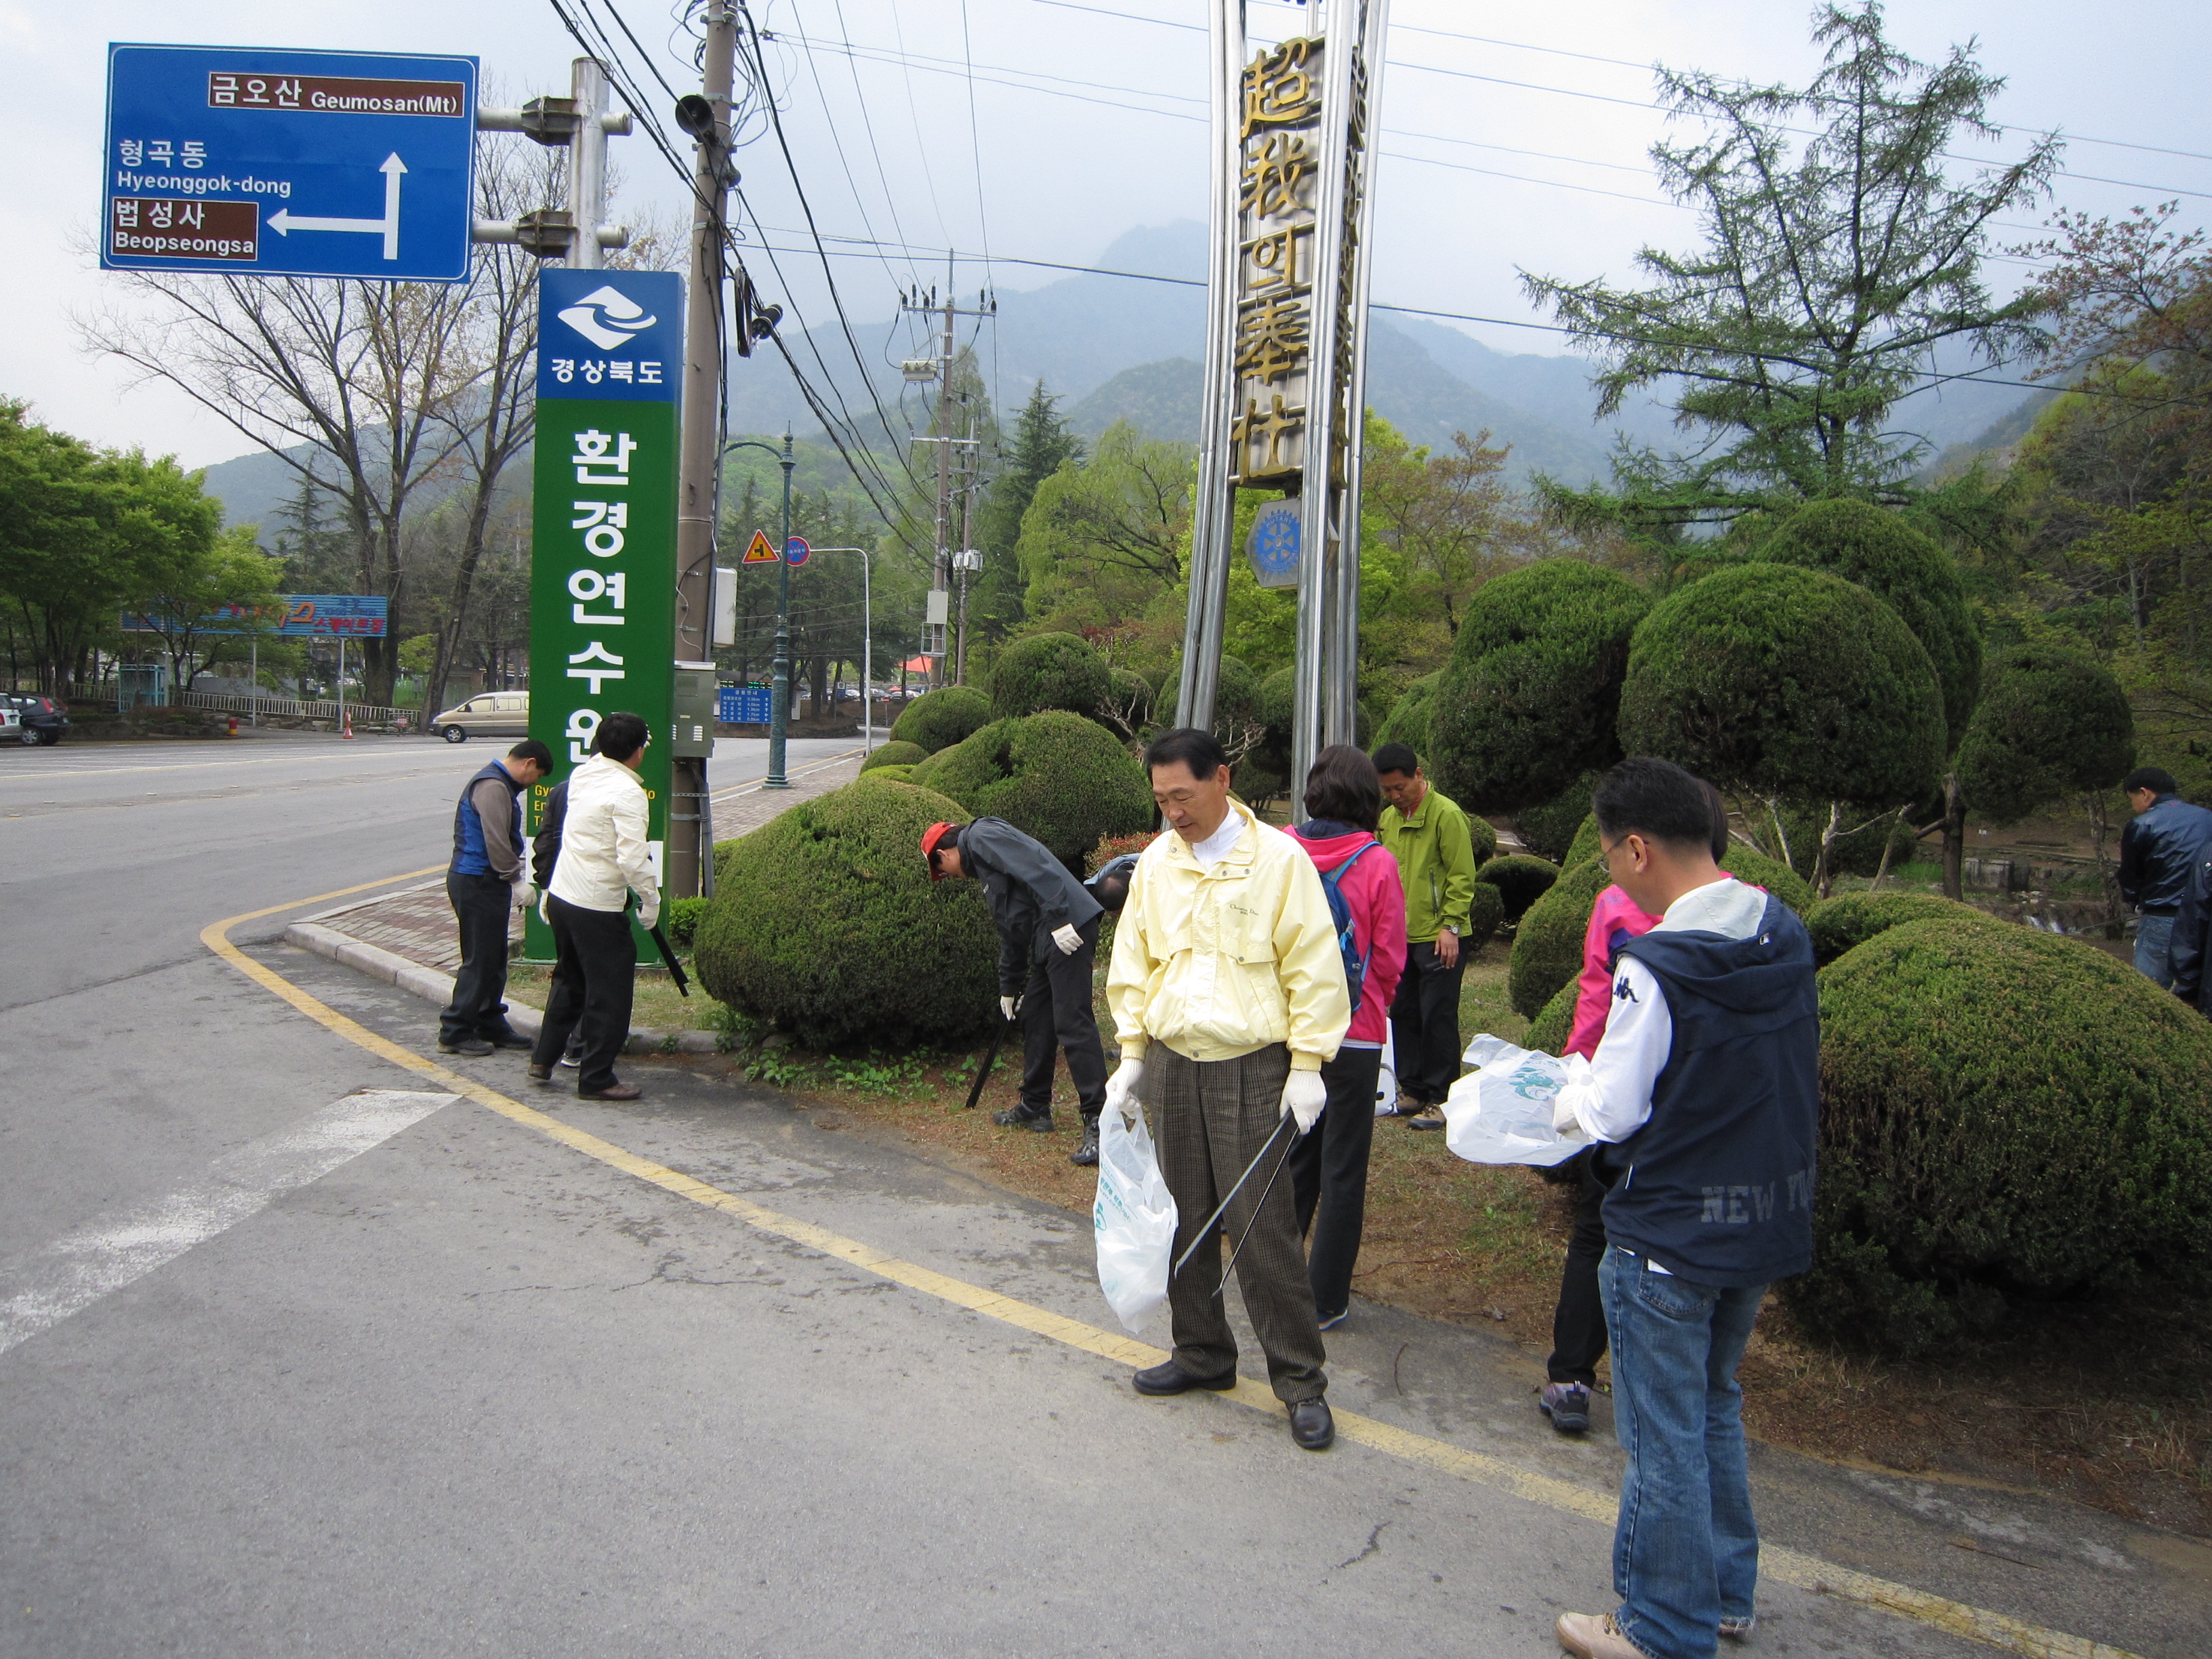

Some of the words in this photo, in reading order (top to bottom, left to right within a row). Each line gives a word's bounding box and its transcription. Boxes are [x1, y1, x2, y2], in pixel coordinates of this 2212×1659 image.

[212, 76, 302, 107] 금오산
[310, 90, 458, 116] Geumosan(Mt)
[119, 140, 207, 169] 형곡동
[117, 170, 291, 198] Hyeonggok-dong
[116, 201, 206, 230] 법성사
[115, 231, 255, 257] Beopseongsa
[551, 359, 663, 384] 경상북도
[1701, 1181, 1775, 1224] NEW
